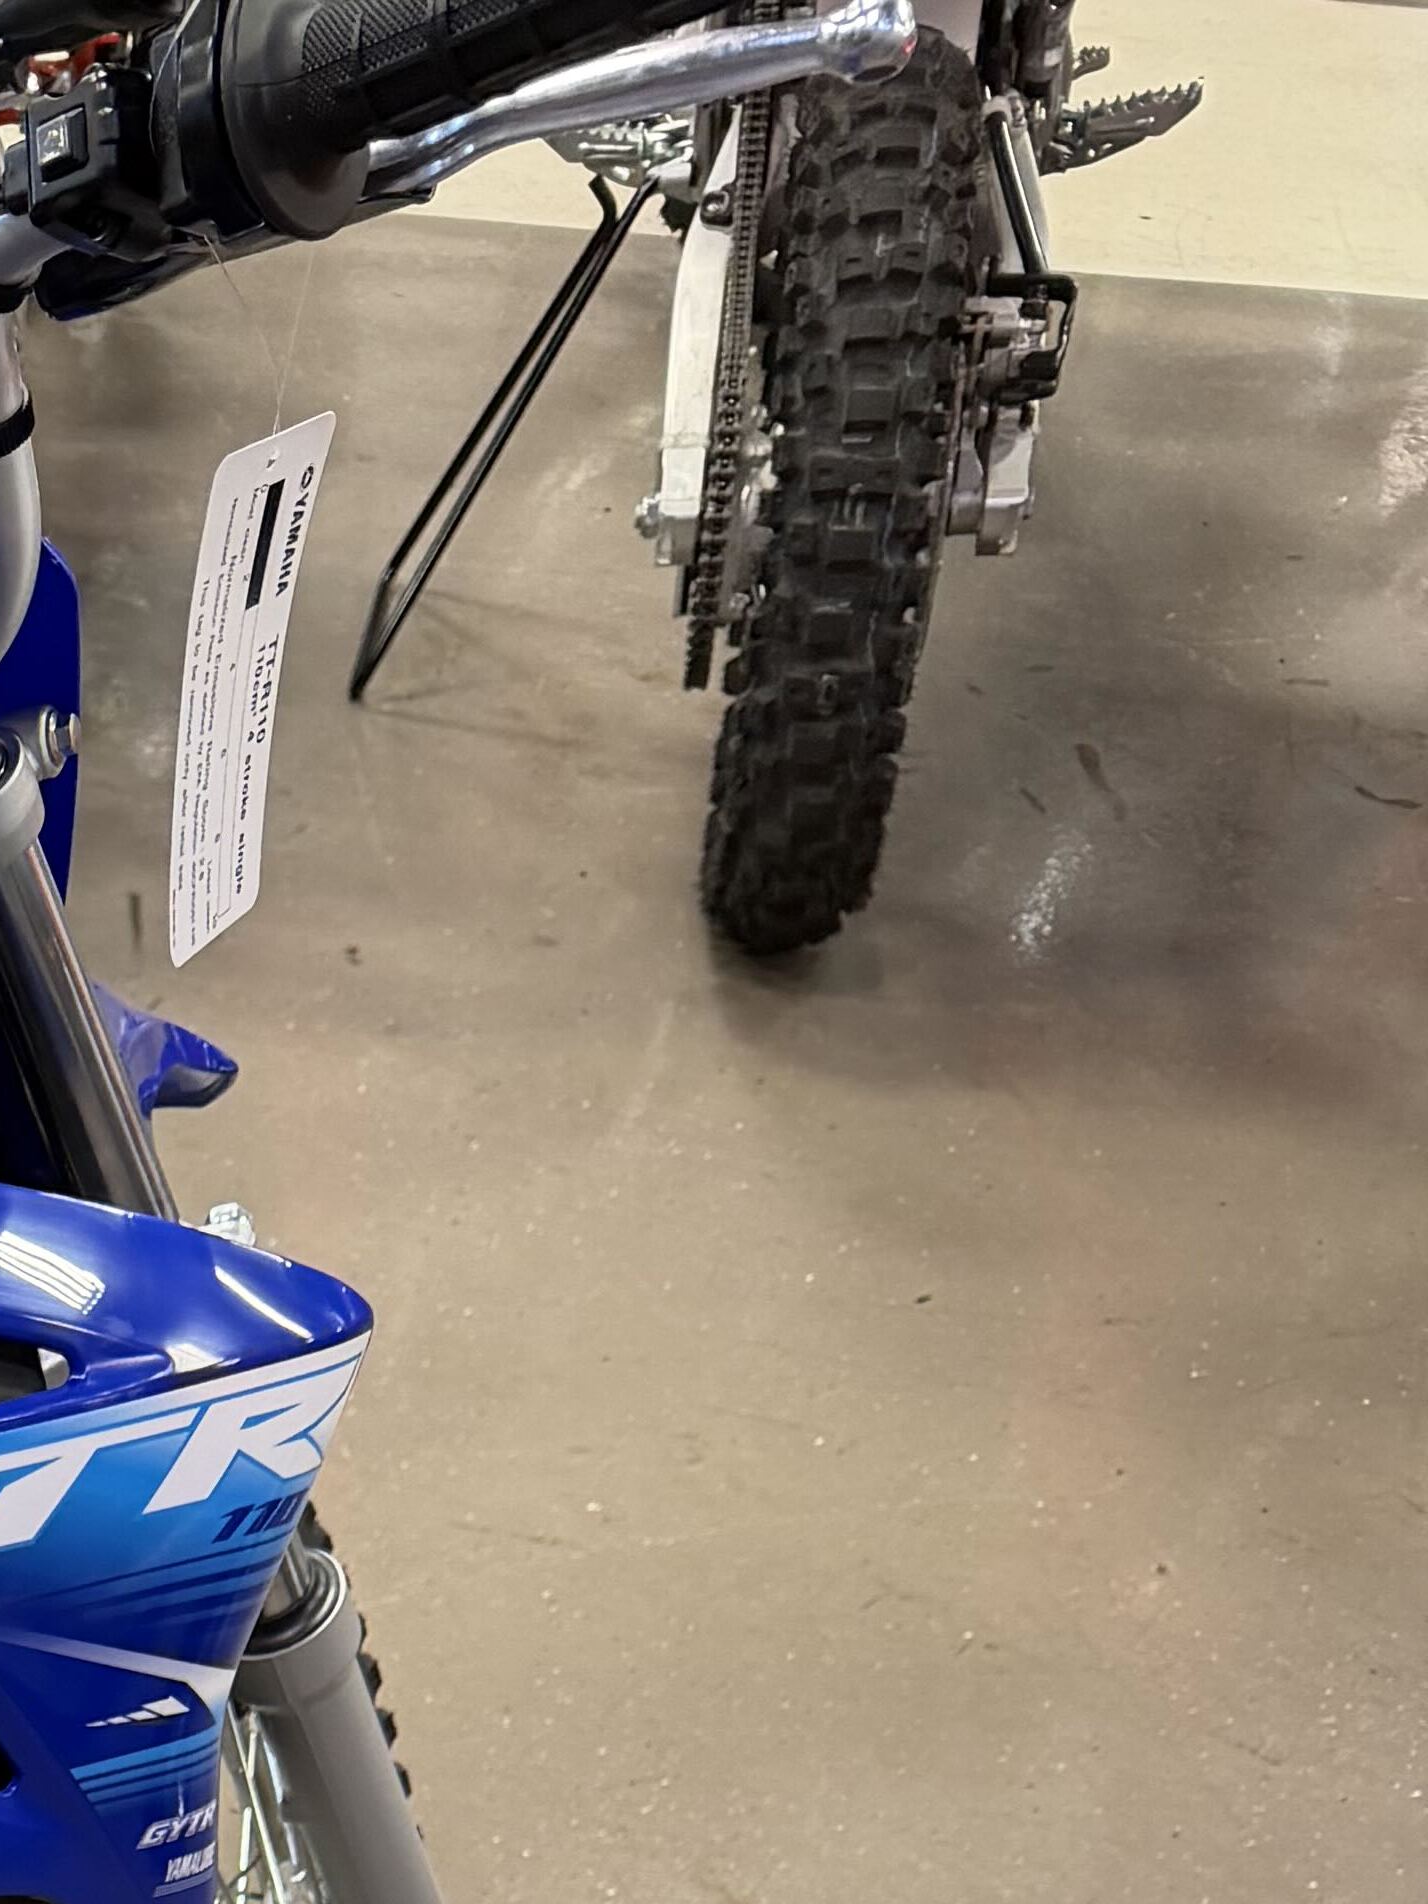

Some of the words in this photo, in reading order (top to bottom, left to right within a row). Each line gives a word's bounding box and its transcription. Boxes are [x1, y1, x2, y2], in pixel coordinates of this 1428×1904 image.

[276, 491, 309, 597] YAMAHA
[256, 633, 279, 744] TT-R110
[211, 1488, 310, 1544] 110
[136, 1799, 216, 1850] GYTR
